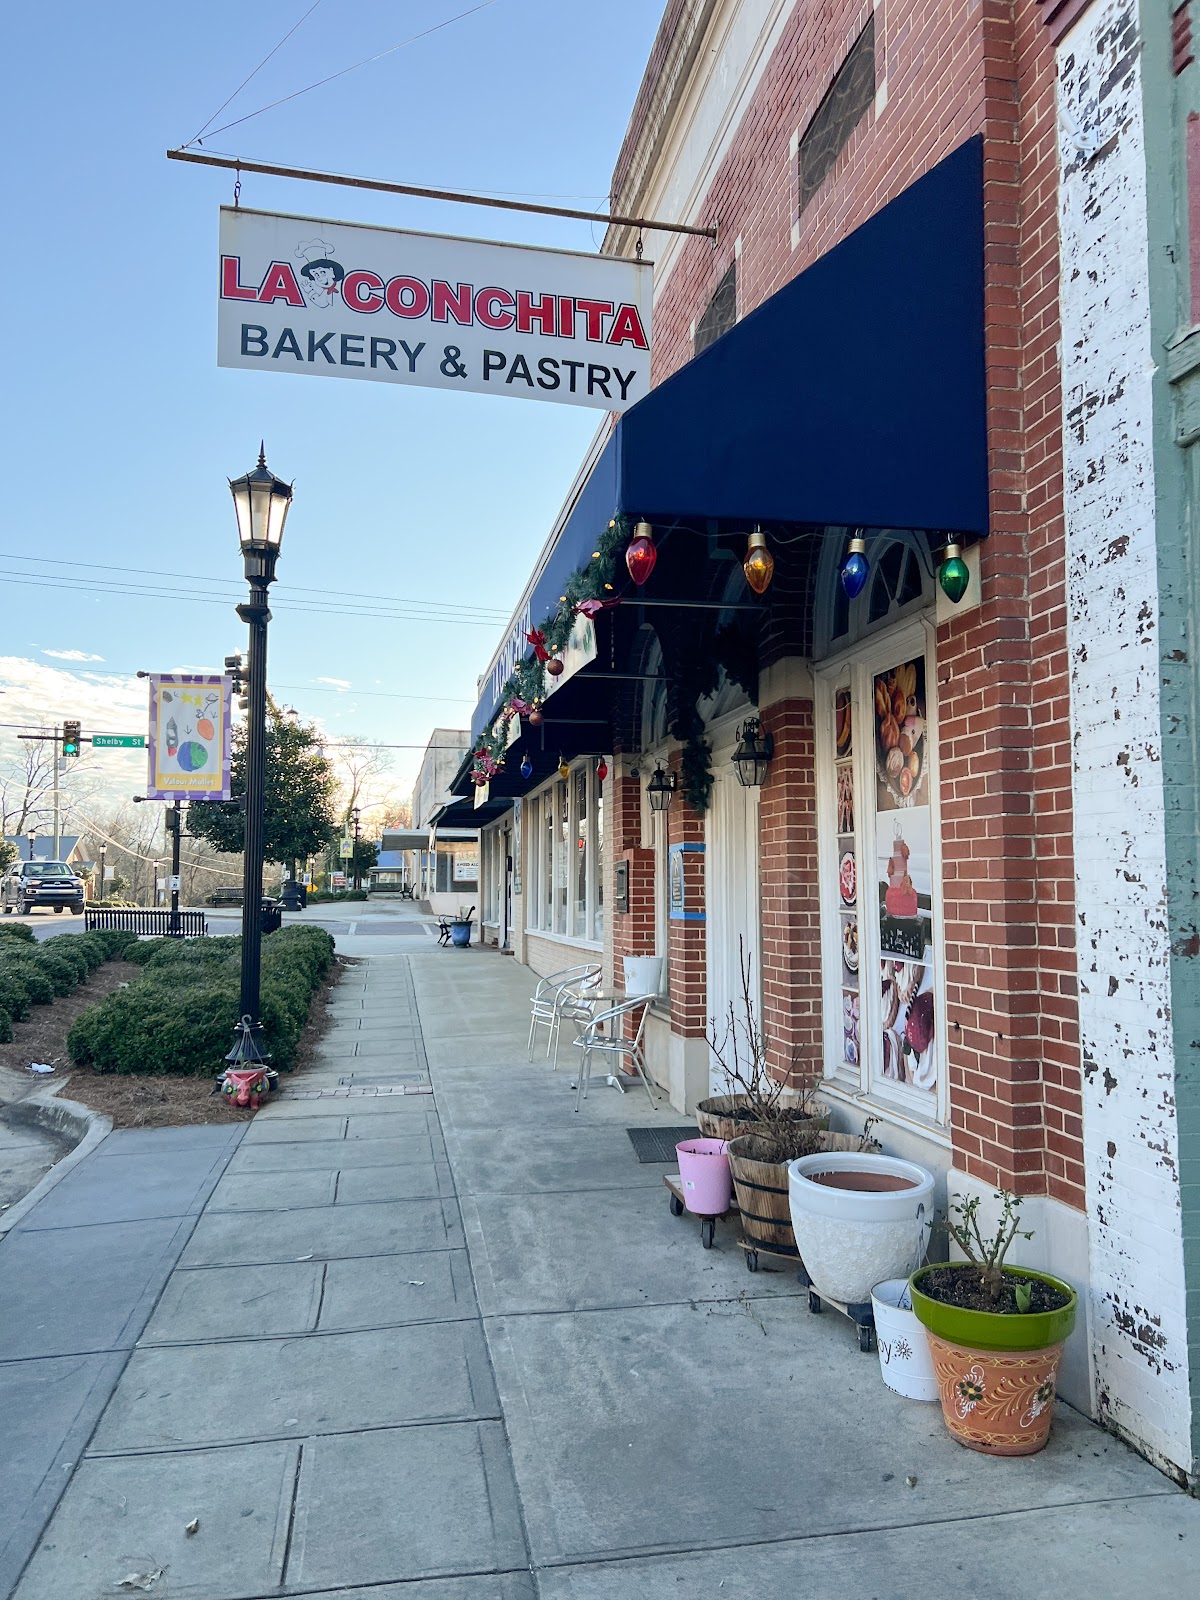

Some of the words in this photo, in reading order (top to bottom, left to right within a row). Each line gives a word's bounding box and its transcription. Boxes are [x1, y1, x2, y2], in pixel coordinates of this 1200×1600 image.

[220, 254, 307, 308] LA
[341, 269, 650, 351] CONCHITA
[240, 323, 427, 373] BAKERY
[438, 345, 468, 379] &
[482, 349, 637, 401] PASTRY
[96, 737, 124, 746] Shelby
[132, 738, 141, 746] St
